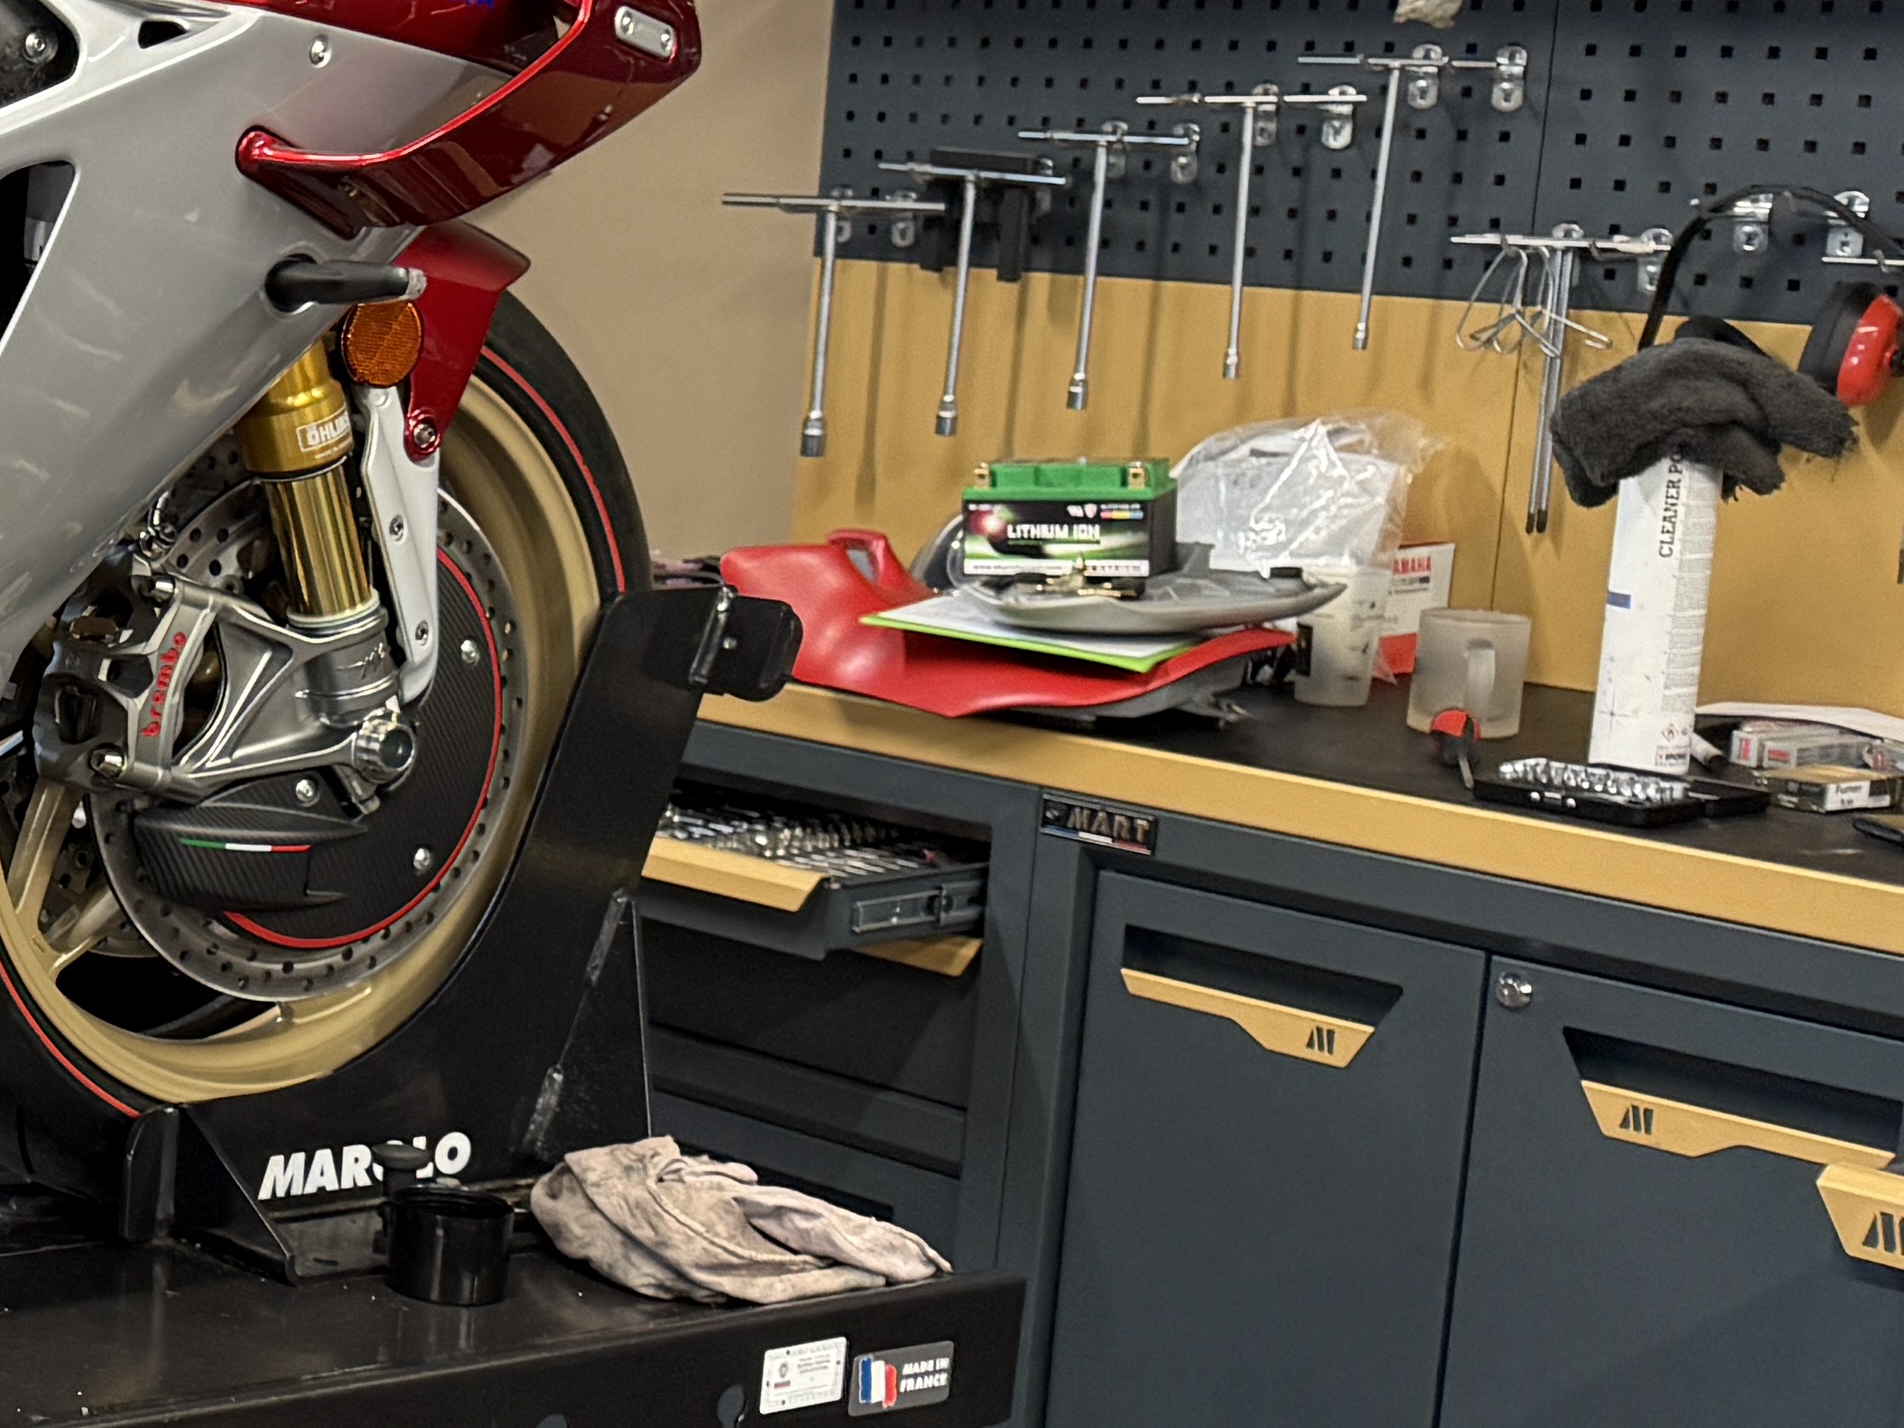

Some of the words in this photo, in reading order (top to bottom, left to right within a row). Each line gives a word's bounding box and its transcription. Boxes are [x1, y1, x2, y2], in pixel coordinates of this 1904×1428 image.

[1007, 523, 1069, 539] LITHIUM
[1073, 524, 1101, 540] ION
[1658, 478, 1682, 559] CLEANER
[140, 631, 188, 738] brembo
[1066, 807, 1151, 843] MART
[257, 1131, 473, 1201] MARLO
[900, 1373, 948, 1394] FRANCE
[902, 1361, 934, 1375] MADE
[935, 1357, 950, 1371] IN
